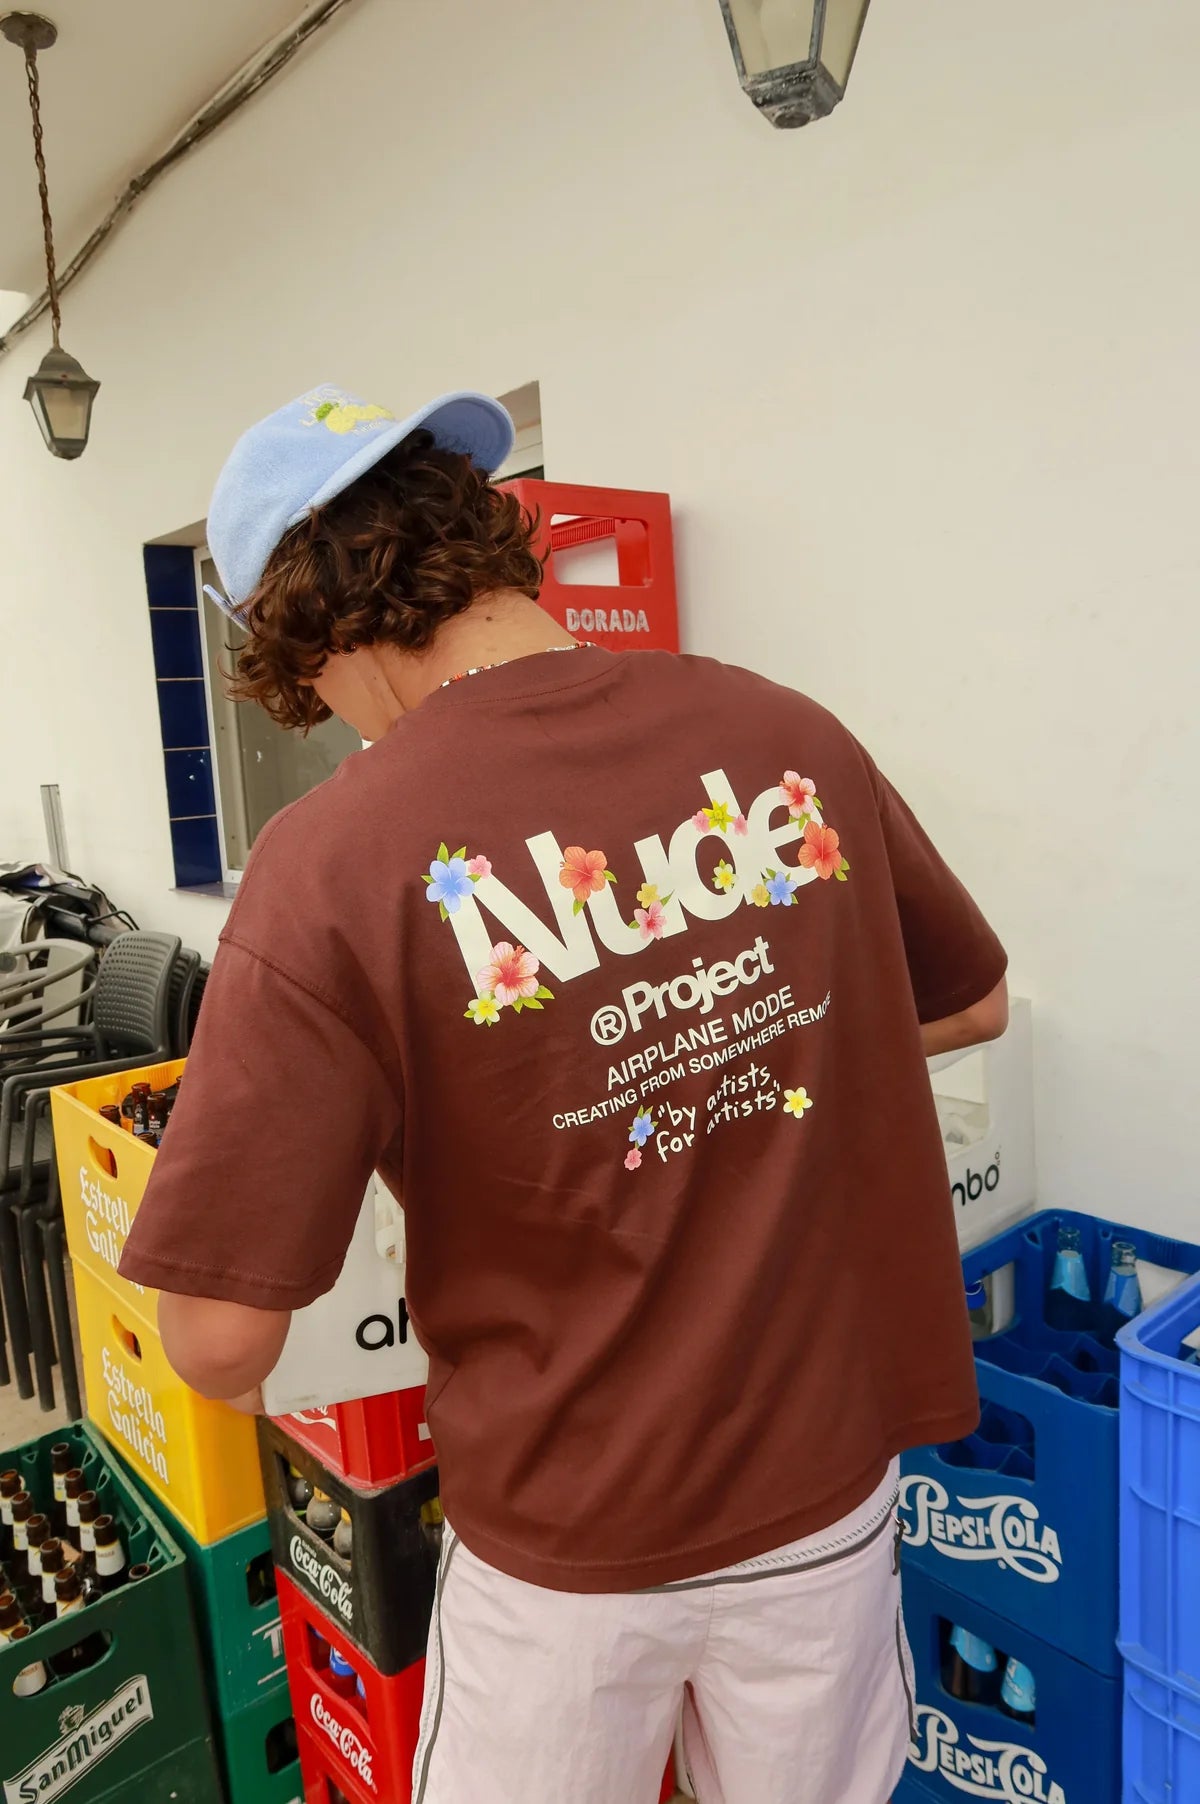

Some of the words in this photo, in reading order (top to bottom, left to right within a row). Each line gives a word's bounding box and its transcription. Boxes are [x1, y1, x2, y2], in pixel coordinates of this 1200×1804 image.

[566, 608, 650, 632] DORADA
[447, 769, 826, 998] Nude
[552, 1088, 638, 1129] CREATING
[640, 1063, 686, 1098] FROM
[688, 1018, 786, 1074] SOMEWHERE
[607, 1018, 728, 1091] AIRPLANE
[731, 984, 795, 1035] MODE
[706, 1062, 771, 1111] artists
[656, 1130, 695, 1163] for
[80, 1166, 136, 1237] Estrell
[102, 1347, 167, 1444] Estrella
[108, 1389, 169, 1485] Galicia
[290, 1535, 353, 1620] Coca-Cola
[310, 1693, 373, 1786] Coca-Cola
